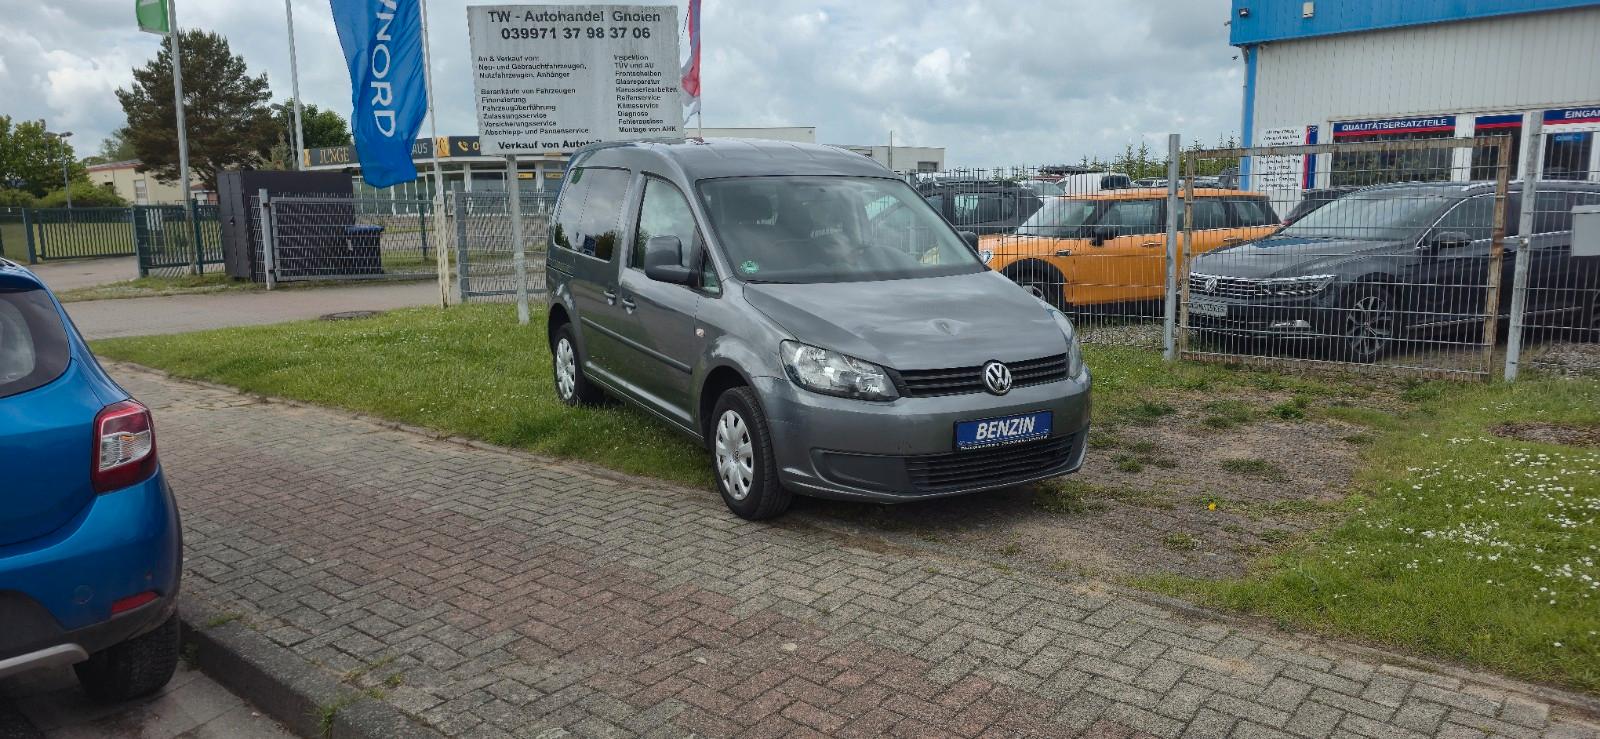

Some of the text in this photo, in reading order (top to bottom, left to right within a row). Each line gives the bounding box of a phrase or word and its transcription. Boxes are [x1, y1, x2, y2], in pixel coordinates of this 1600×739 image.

[488, 11, 511, 23] TW
[524, 10, 604, 23] Autohandel
[612, 10, 661, 22] Gnoien
[501, 26, 651, 39] 039971 37 98 37 06
[478, 63, 495, 71] Neu-
[614, 61, 629, 69] TÜV
[536, 71, 570, 79] Anhänger
[615, 78, 661, 86] Glasreparatur
[535, 87, 576, 95] Fahrzeugen
[481, 96, 527, 104] Finanzierung
[483, 112, 547, 120] Zulassungsservice
[617, 110, 649, 118] Diagnose
[1564, 109, 1600, 119] EINGA
[484, 120, 557, 128] Versicherungsservice
[1341, 118, 1448, 131] QUALITÄTSERSATZTEILE
[539, 127, 589, 135] Pannenservice
[618, 126, 647, 134] Montage
[411, 143, 428, 155] AUS
[498, 140, 538, 150] Verkauf
[319, 147, 350, 164] JUNGE
[975, 416, 1036, 440] BENZIN
